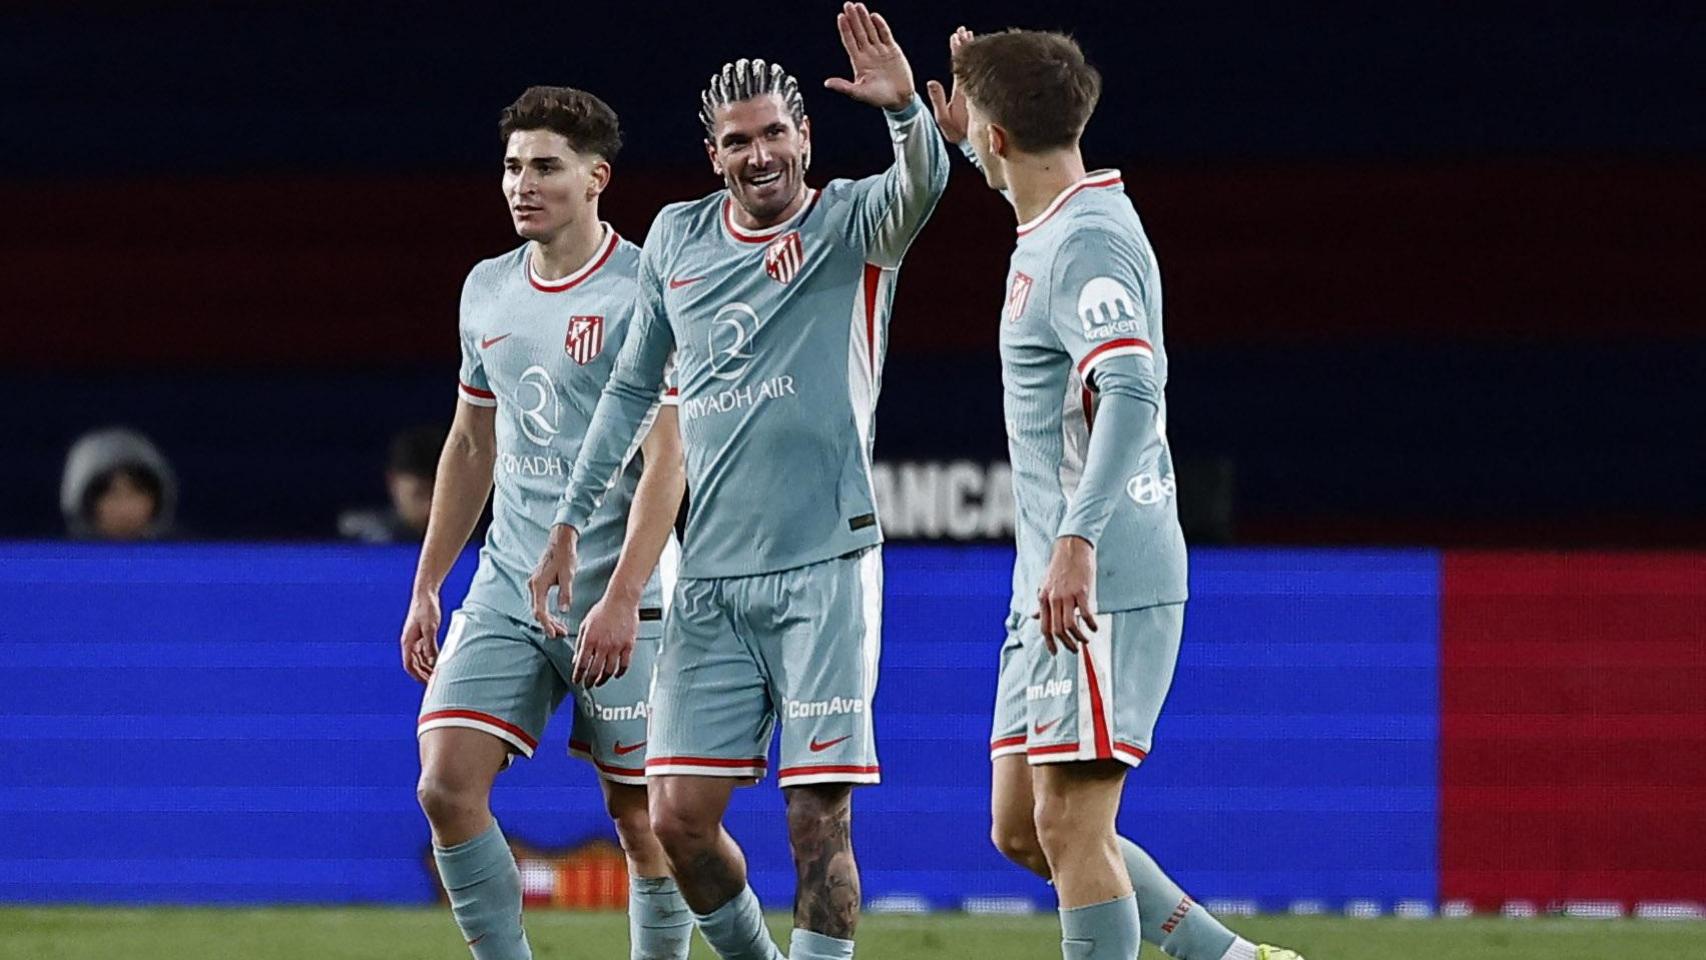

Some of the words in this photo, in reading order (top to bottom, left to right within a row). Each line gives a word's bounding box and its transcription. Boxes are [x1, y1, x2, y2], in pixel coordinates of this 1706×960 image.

[1084, 320, 1139, 342] kraken
[684, 384, 753, 420] RIYADH
[759, 375, 796, 403] AIR
[501, 452, 562, 477] RIYADH
[789, 696, 862, 719] ComAve
